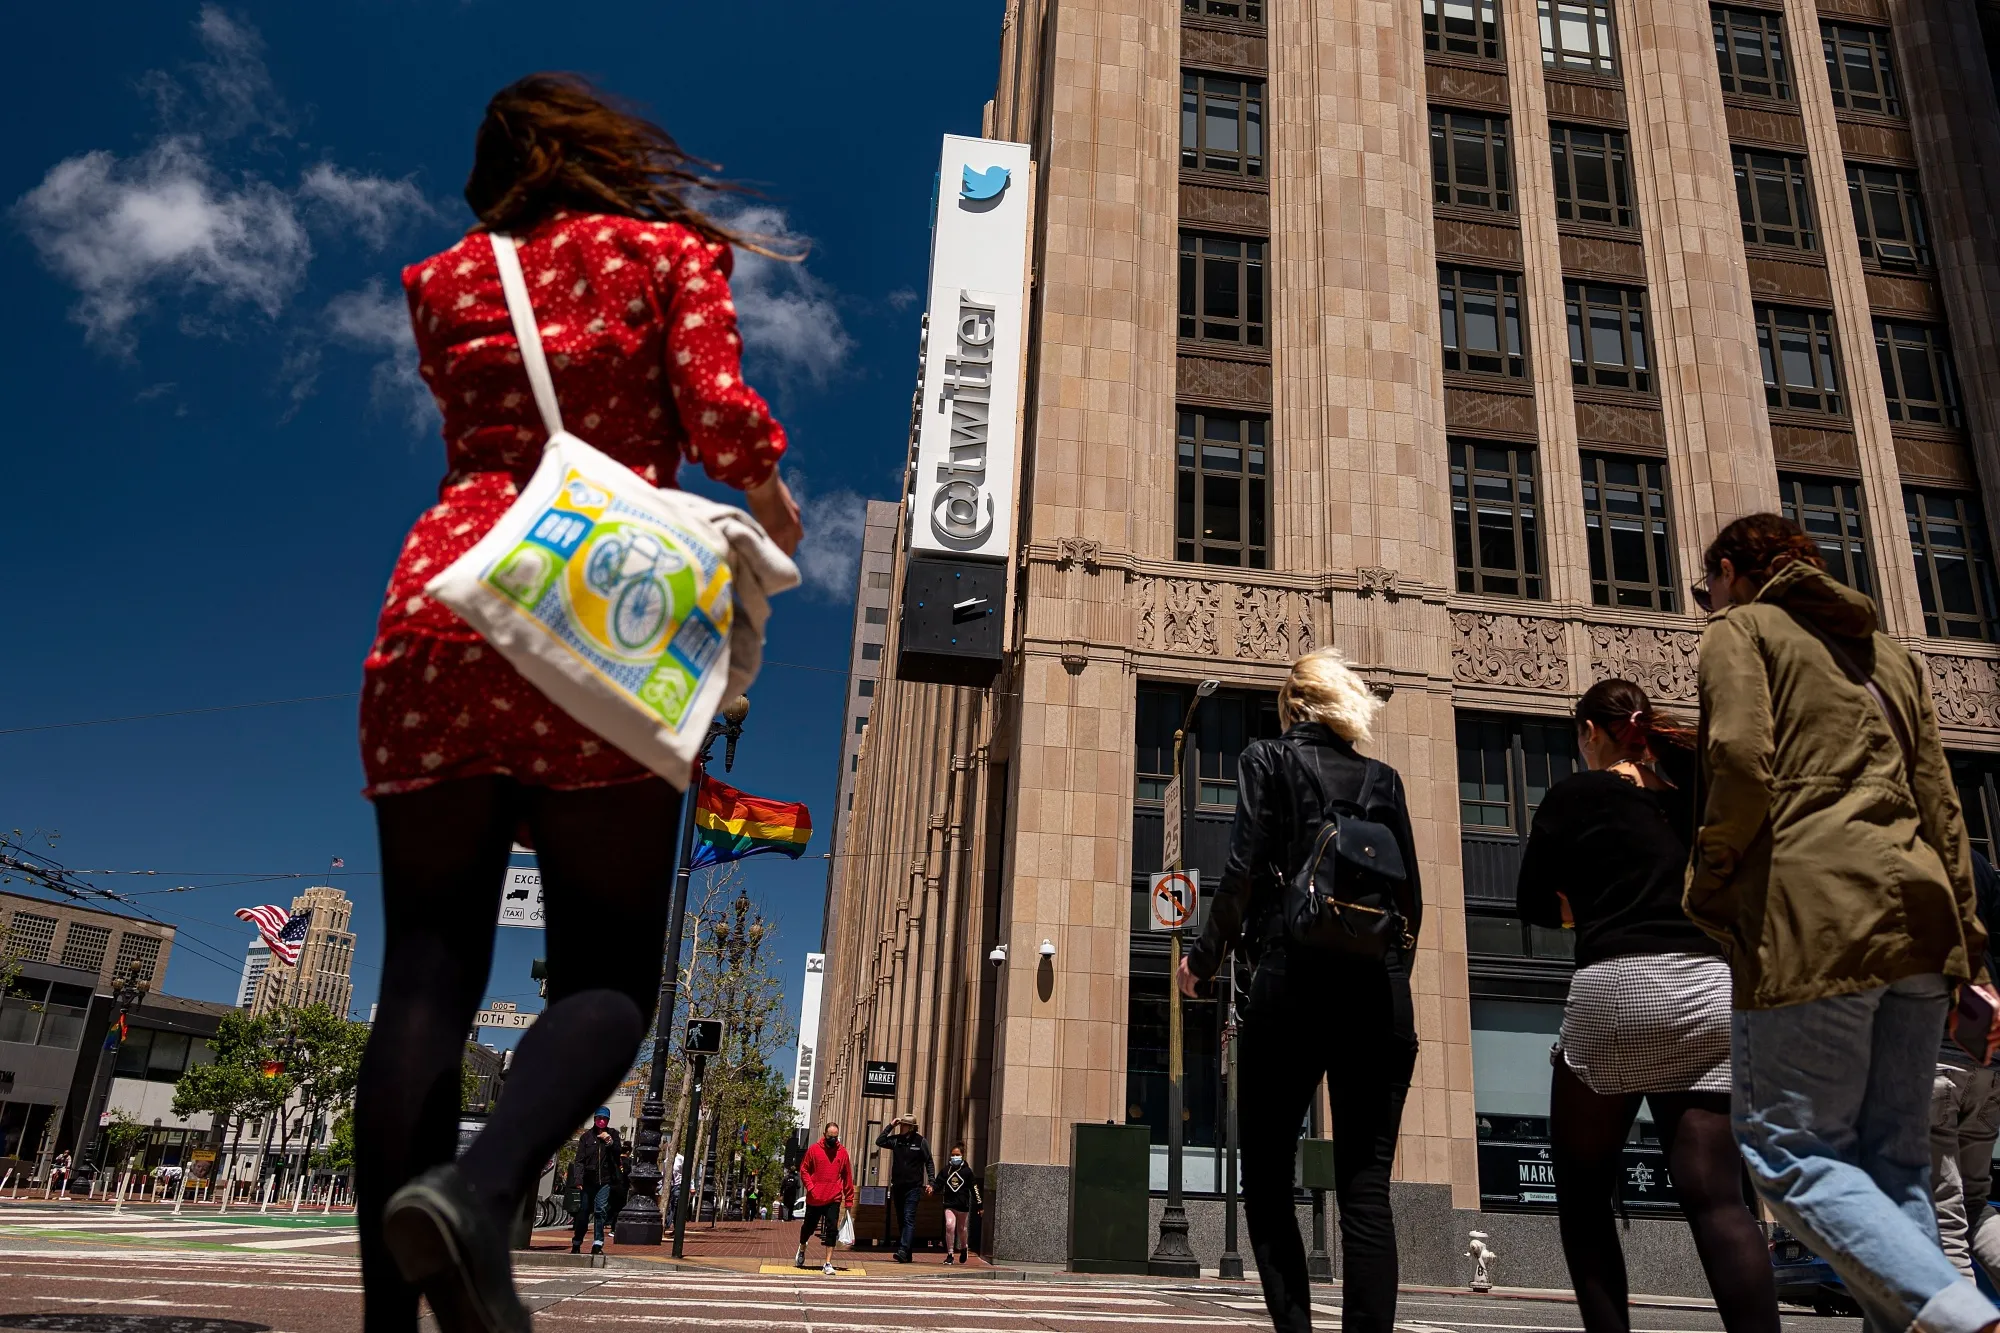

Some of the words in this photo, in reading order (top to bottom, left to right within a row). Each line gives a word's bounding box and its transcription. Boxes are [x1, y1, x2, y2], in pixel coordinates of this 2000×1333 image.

[931, 289, 996, 540] @twitter
[1165, 785, 1179, 808] SPEED
[1166, 804, 1178, 826] LIMIT
[1164, 824, 1179, 862] 25
[515, 875, 541, 885] EXCE
[506, 910, 523, 918] TAXI
[477, 1013, 505, 1025] 10TH
[513, 1015, 528, 1026] ST
[797, 1044, 813, 1100] DOLBY
[868, 1072, 895, 1083] MARKET
[1519, 1164, 1556, 1183] MARK
